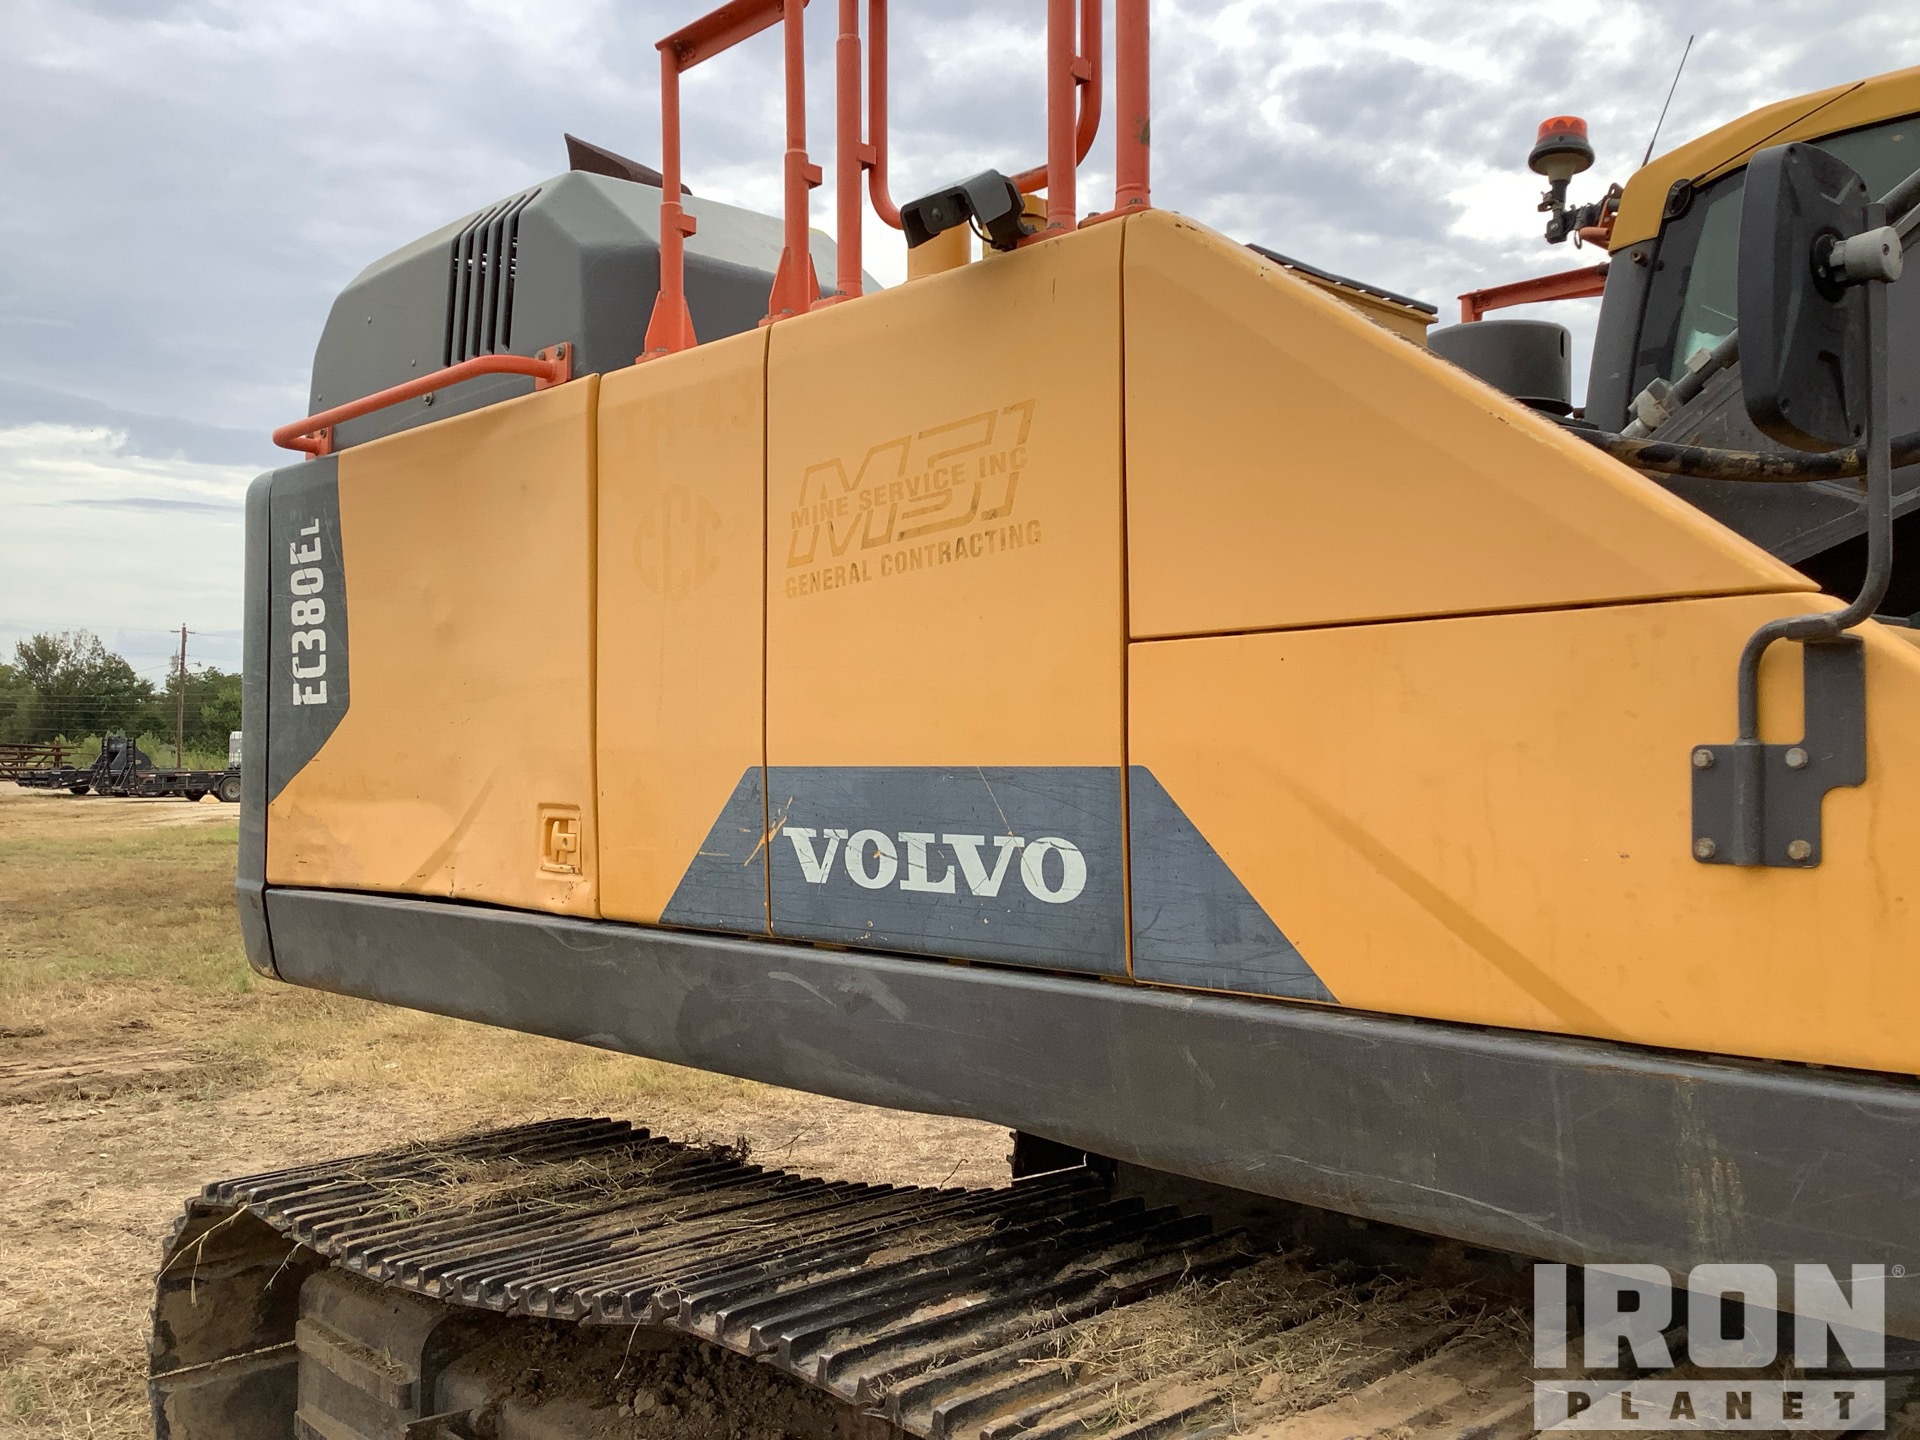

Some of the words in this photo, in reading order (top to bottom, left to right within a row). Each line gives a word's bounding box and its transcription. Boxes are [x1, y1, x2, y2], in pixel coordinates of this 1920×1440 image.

[790, 496, 850, 529] MINE
[859, 462, 967, 512] SERVICE
[978, 447, 1029, 478] INC
[785, 560, 873, 600] GENERAL
[880, 519, 1043, 578] CONTRACTING
[290, 518, 328, 706] EC380EL
[782, 826, 1087, 904] VOLVO
